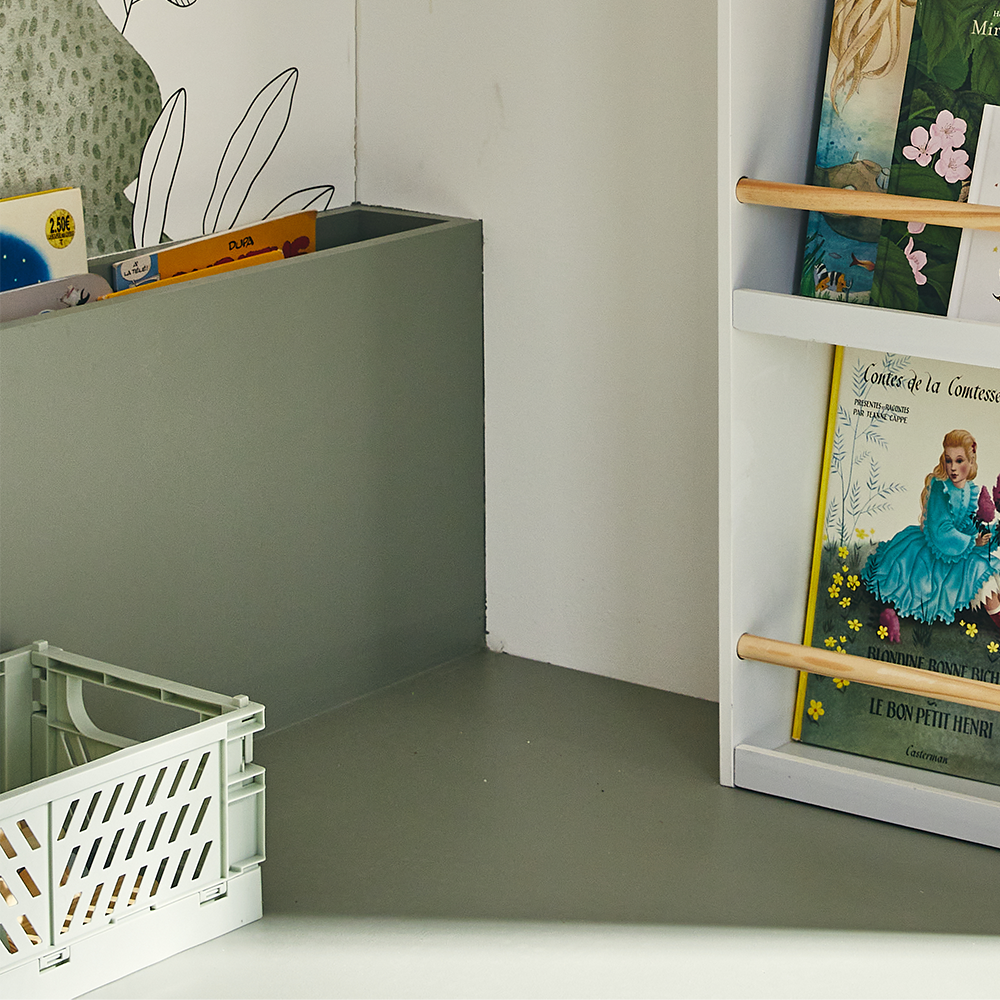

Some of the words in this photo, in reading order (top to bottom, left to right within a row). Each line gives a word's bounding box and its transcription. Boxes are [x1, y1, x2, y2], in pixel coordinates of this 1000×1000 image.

[49, 214, 71, 234] 2.50€
[228, 236, 254, 251] DUPA
[863, 362, 902, 388] Contes
[907, 369, 922, 396] de
[925, 371, 941, 394] la
[852, 408, 865, 417] PAR
[866, 410, 887, 421] JEANNE
[889, 414, 908, 424] CAPPE
[867, 645, 925, 669] BLONDINE
[928, 657, 968, 678] BONNE
[869, 697, 883, 716] LE
[886, 700, 914, 722] BON
[915, 706, 951, 730] PETIT
[953, 715, 994, 739] HENRI
[905, 744, 948, 764] Casterman
